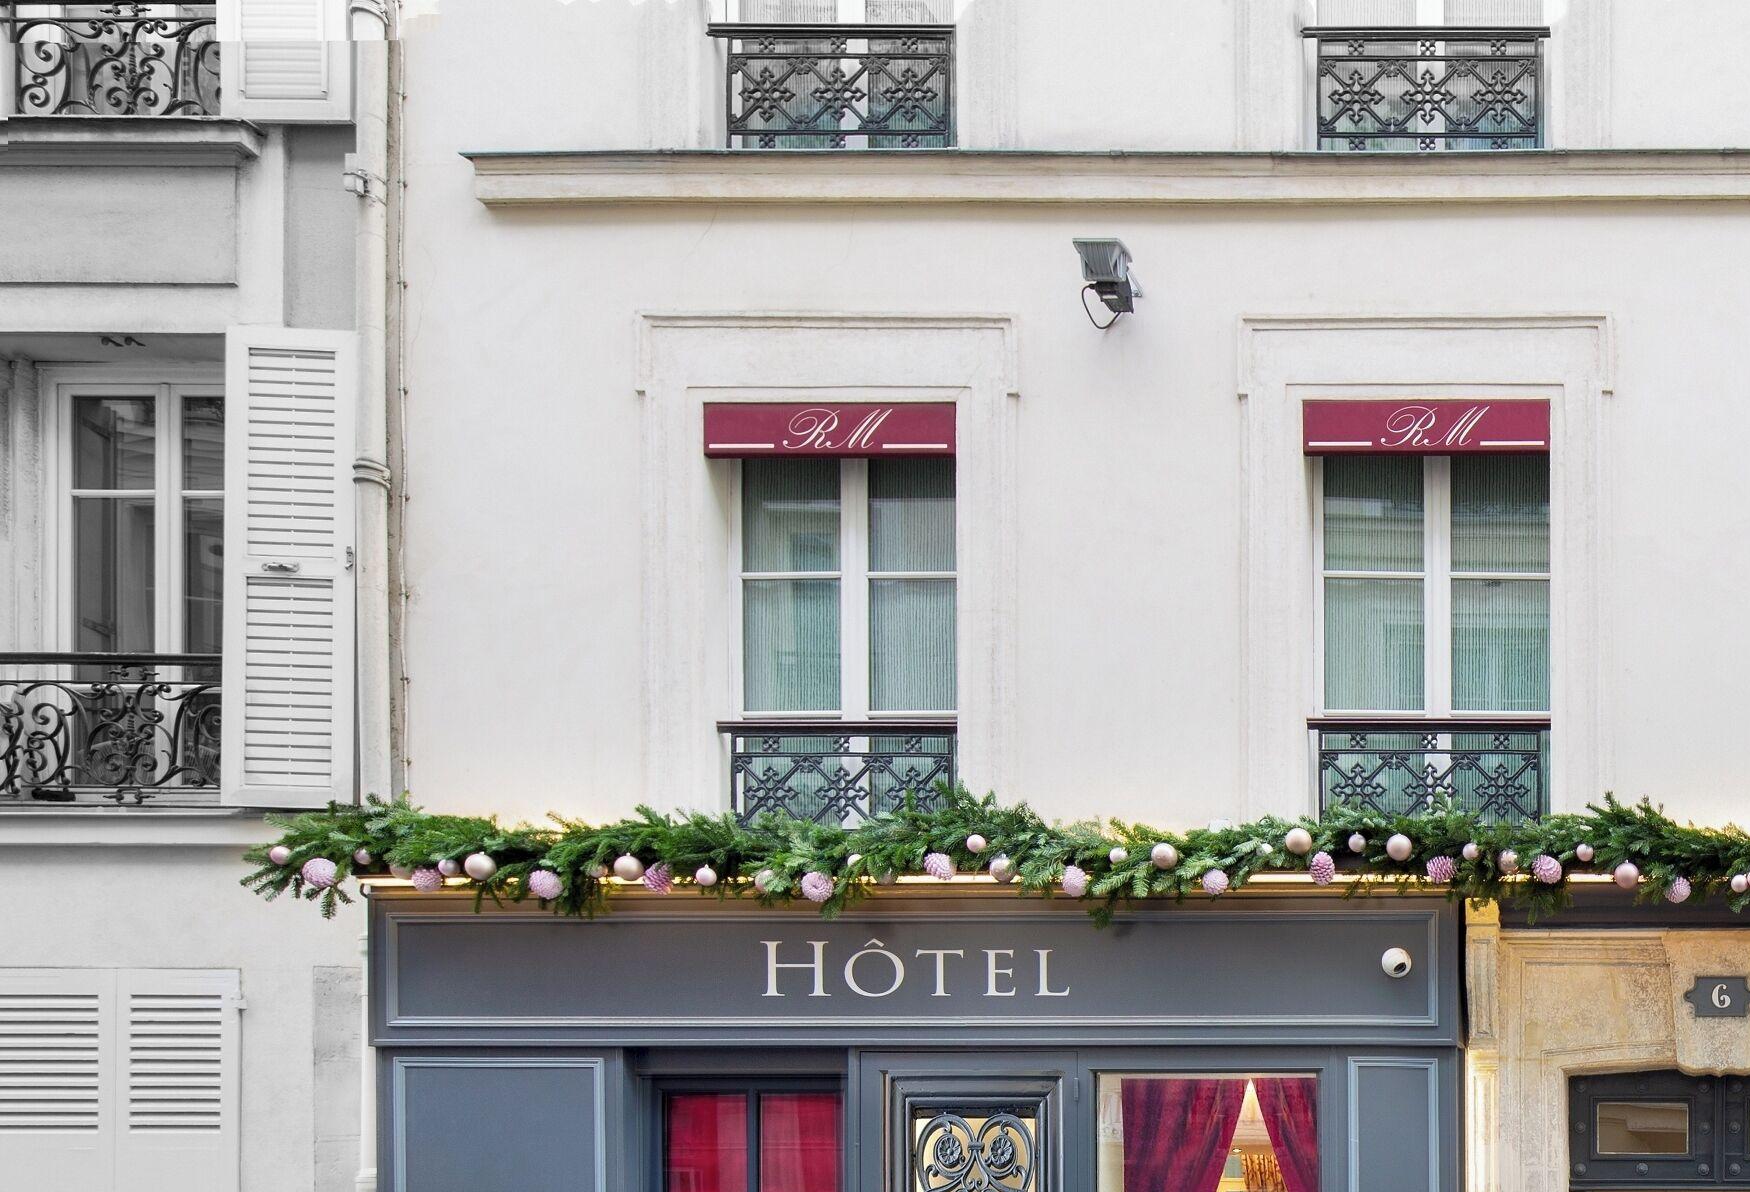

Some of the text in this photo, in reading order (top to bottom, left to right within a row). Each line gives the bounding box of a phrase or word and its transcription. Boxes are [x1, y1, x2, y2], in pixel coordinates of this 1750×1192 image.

[782, 405, 893, 450] RM
[1380, 405, 1491, 448] RM
[759, 938, 1071, 998] HÔTEL
[1711, 983, 1732, 1009] 6
